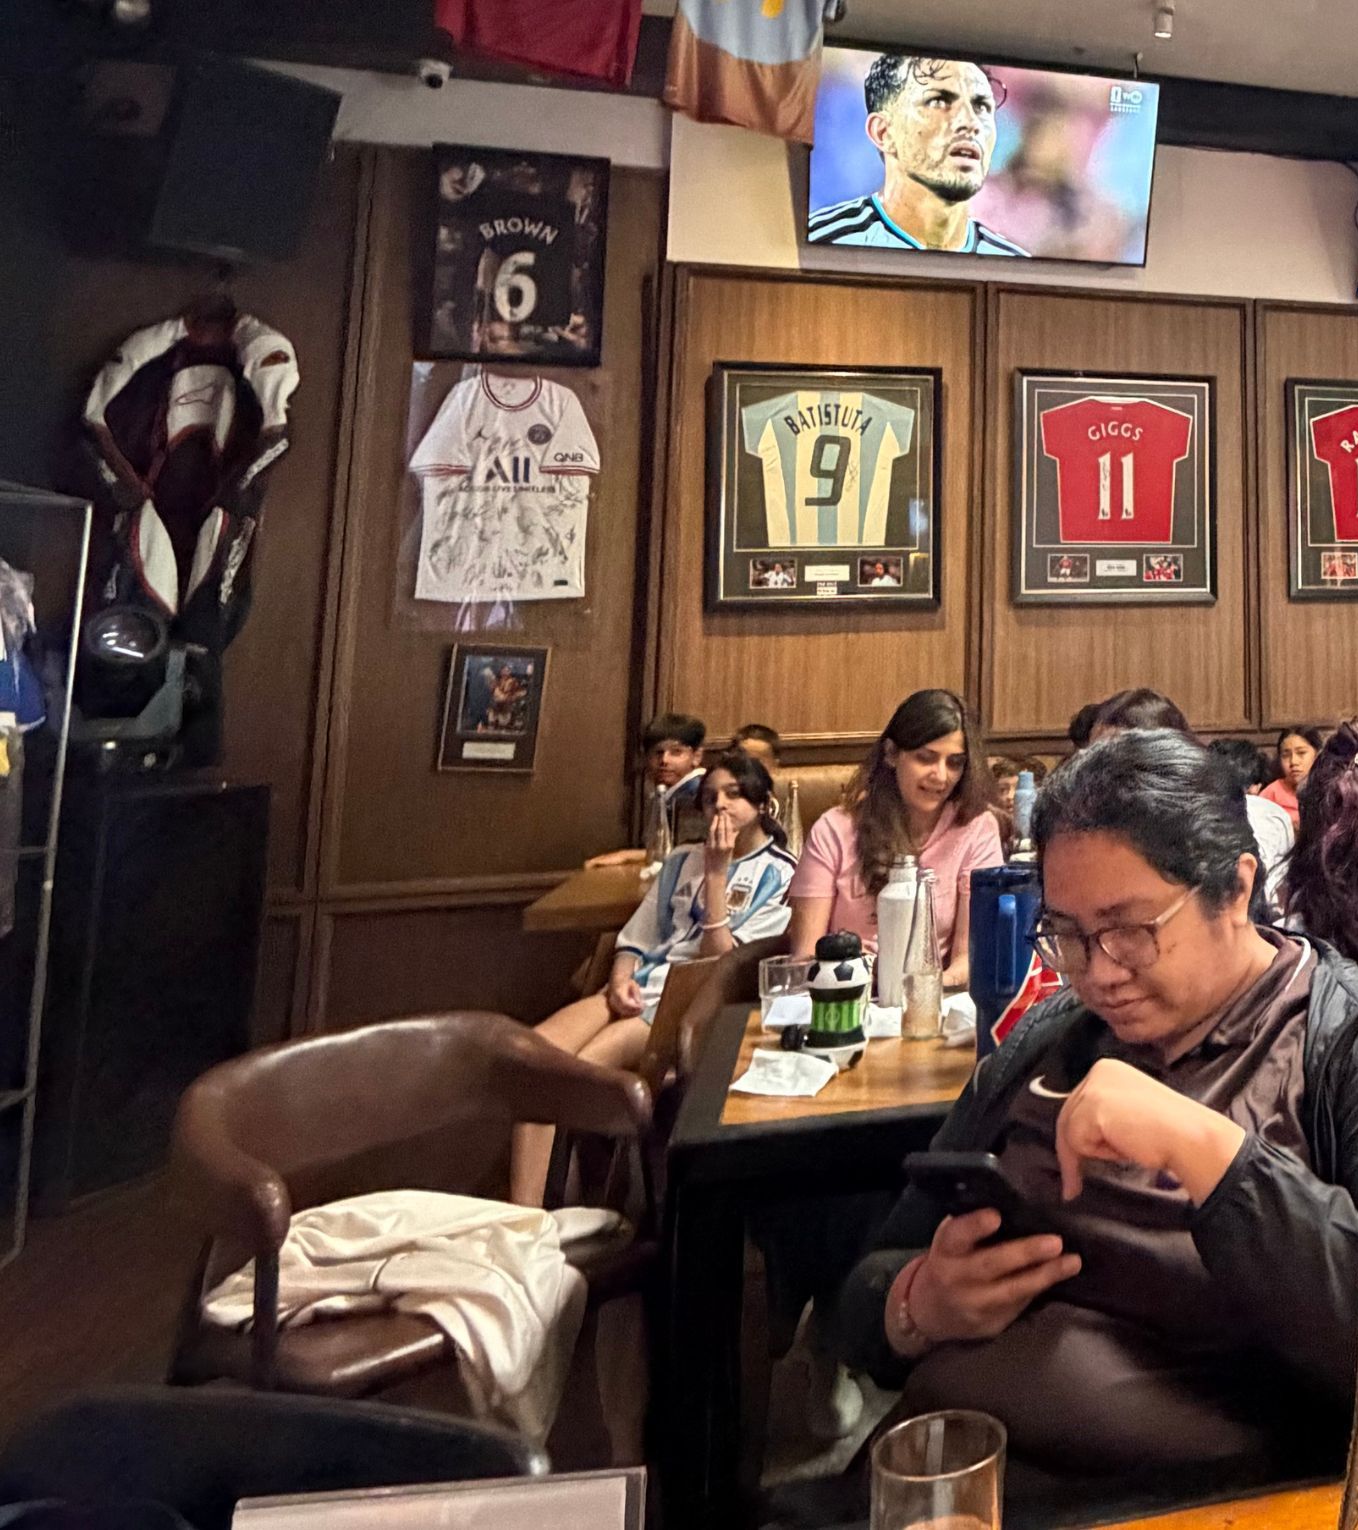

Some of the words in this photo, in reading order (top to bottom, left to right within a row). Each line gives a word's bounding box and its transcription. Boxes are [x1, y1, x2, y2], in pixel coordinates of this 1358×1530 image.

[479, 217, 558, 244] BROWN
[494, 251, 537, 322] 6
[784, 403, 872, 436] BATISTUTA
[1088, 421, 1143, 441] GIGGS
[553, 453, 584, 463] QNB
[805, 435, 851, 507] 9
[1098, 451, 1134, 520] 11
